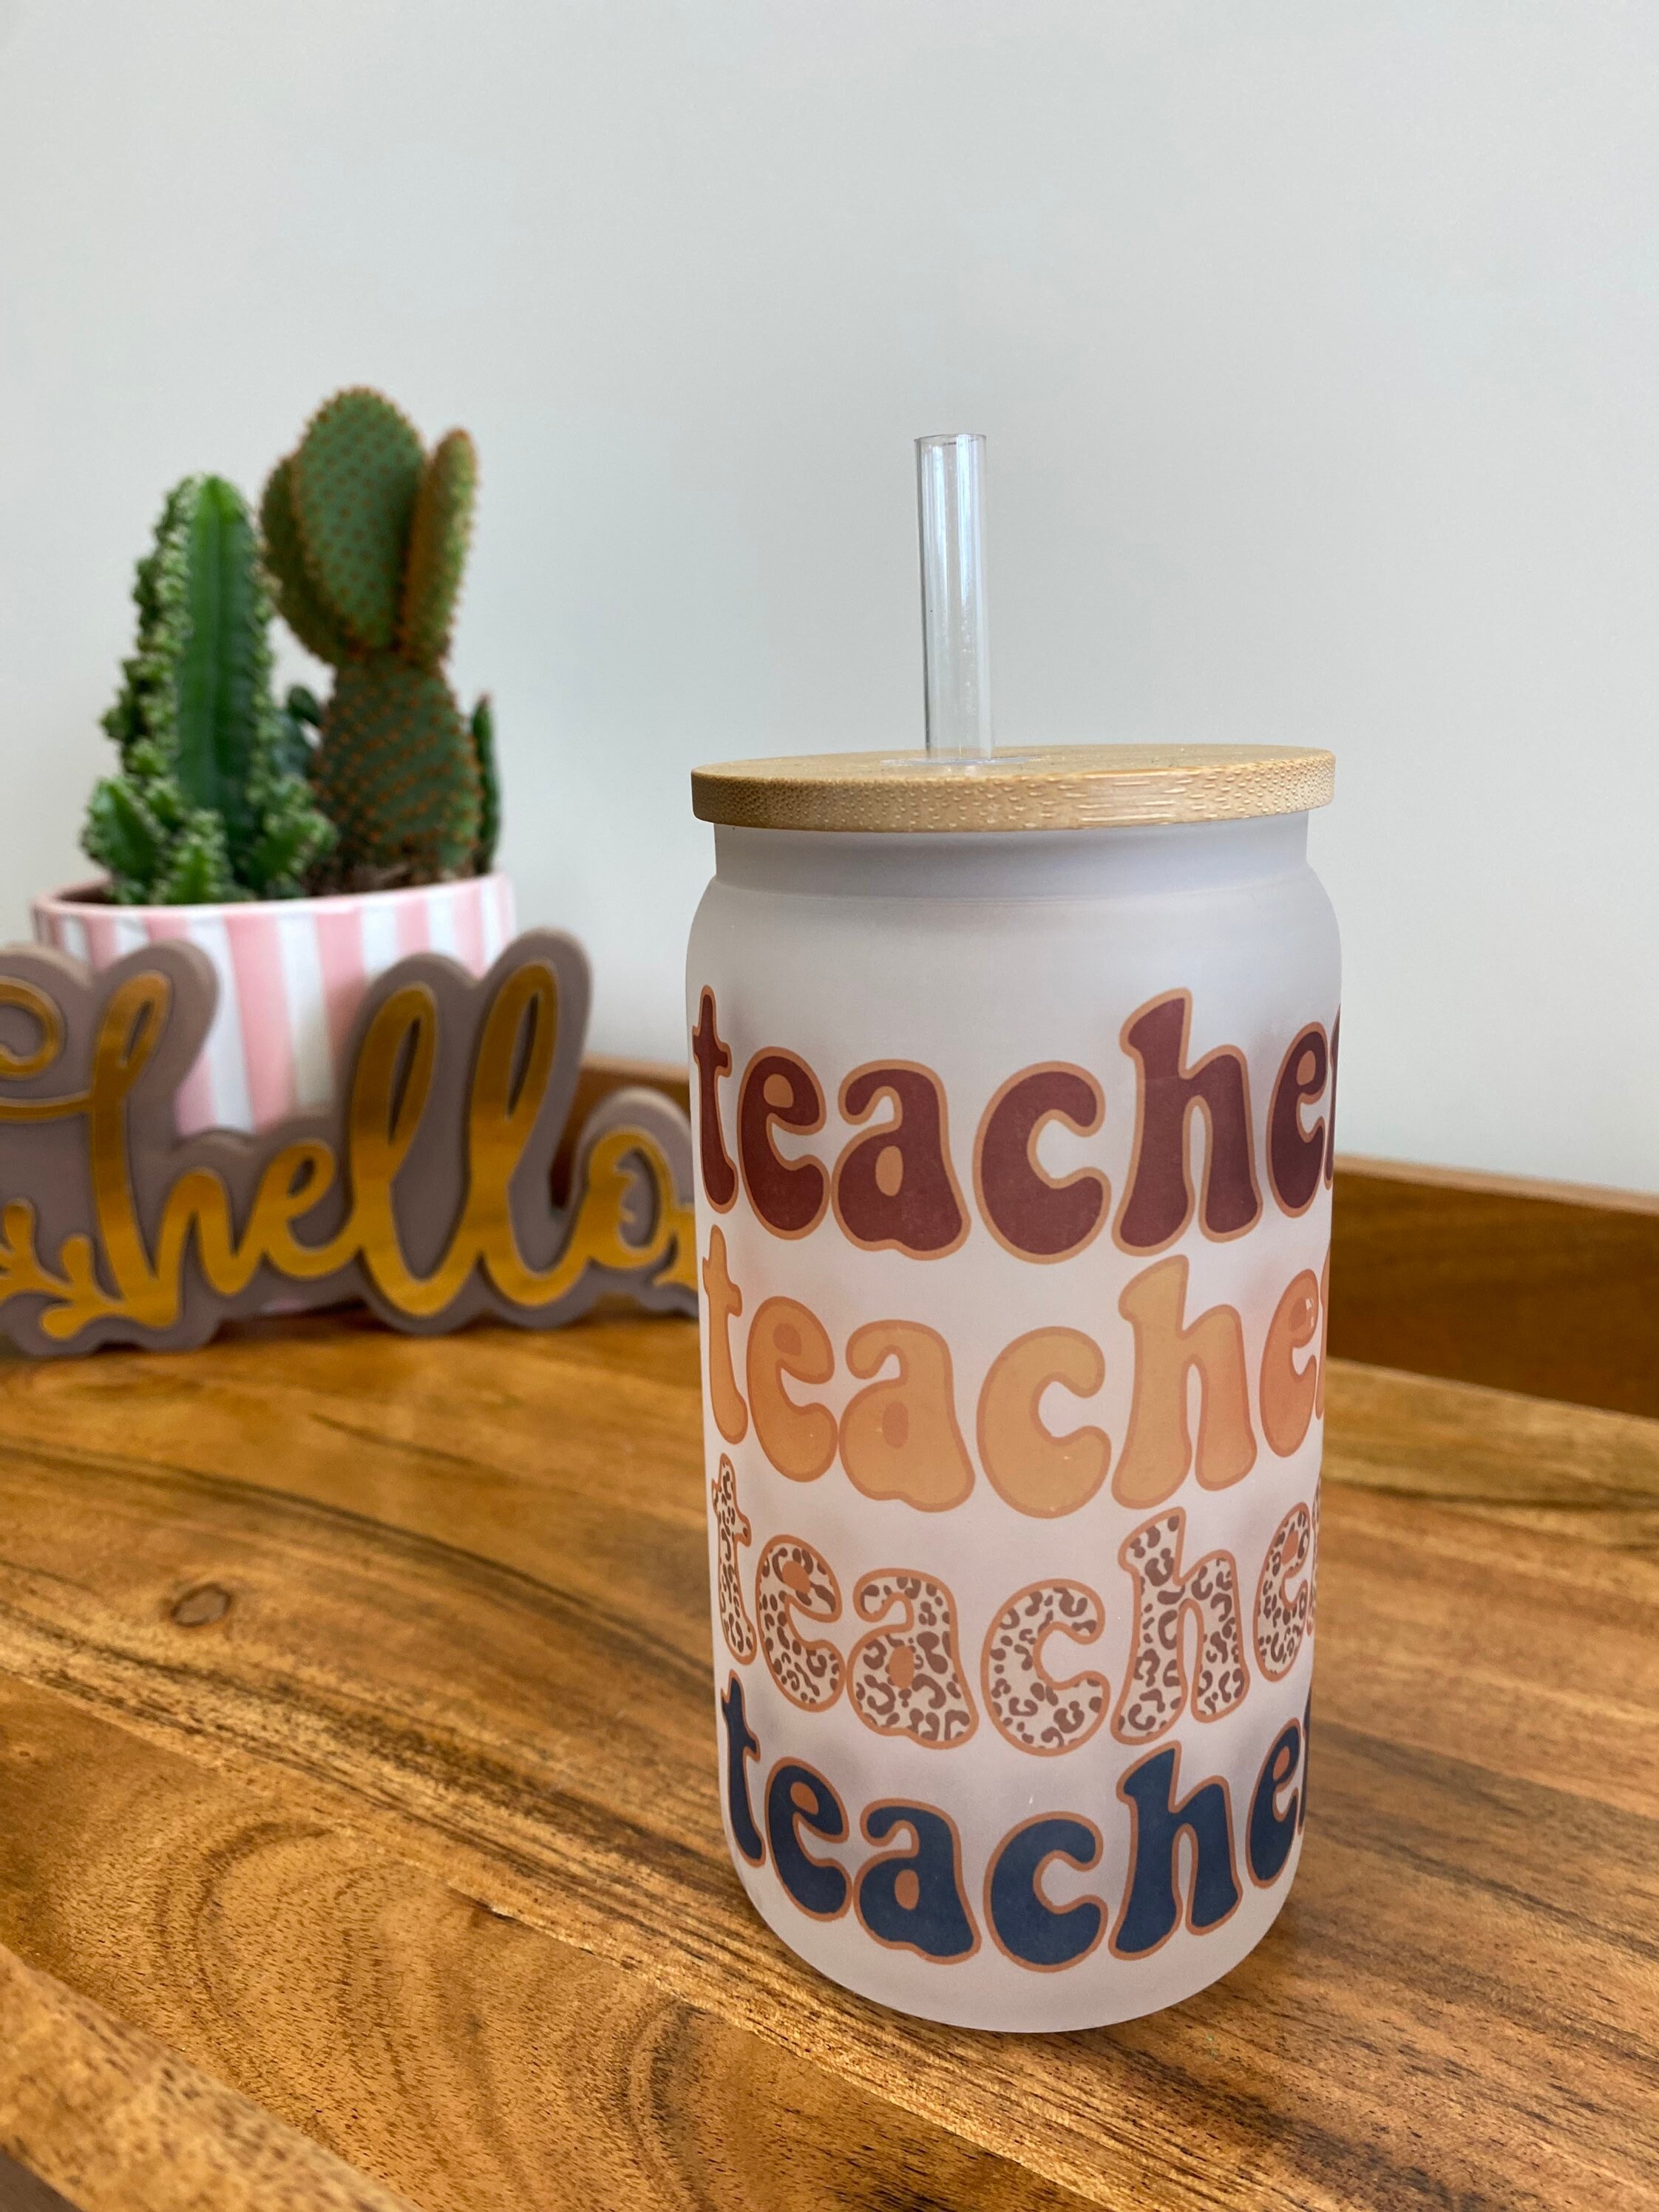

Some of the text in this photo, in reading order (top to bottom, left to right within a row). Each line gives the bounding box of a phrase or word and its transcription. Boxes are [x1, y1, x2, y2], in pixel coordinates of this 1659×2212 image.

[0, 961, 698, 1339] hello
[691, 985, 1340, 1264] teache
[702, 1224, 1330, 1519] teache
[712, 1453, 1321, 1757] teache
[721, 1670, 1311, 1973] teache
